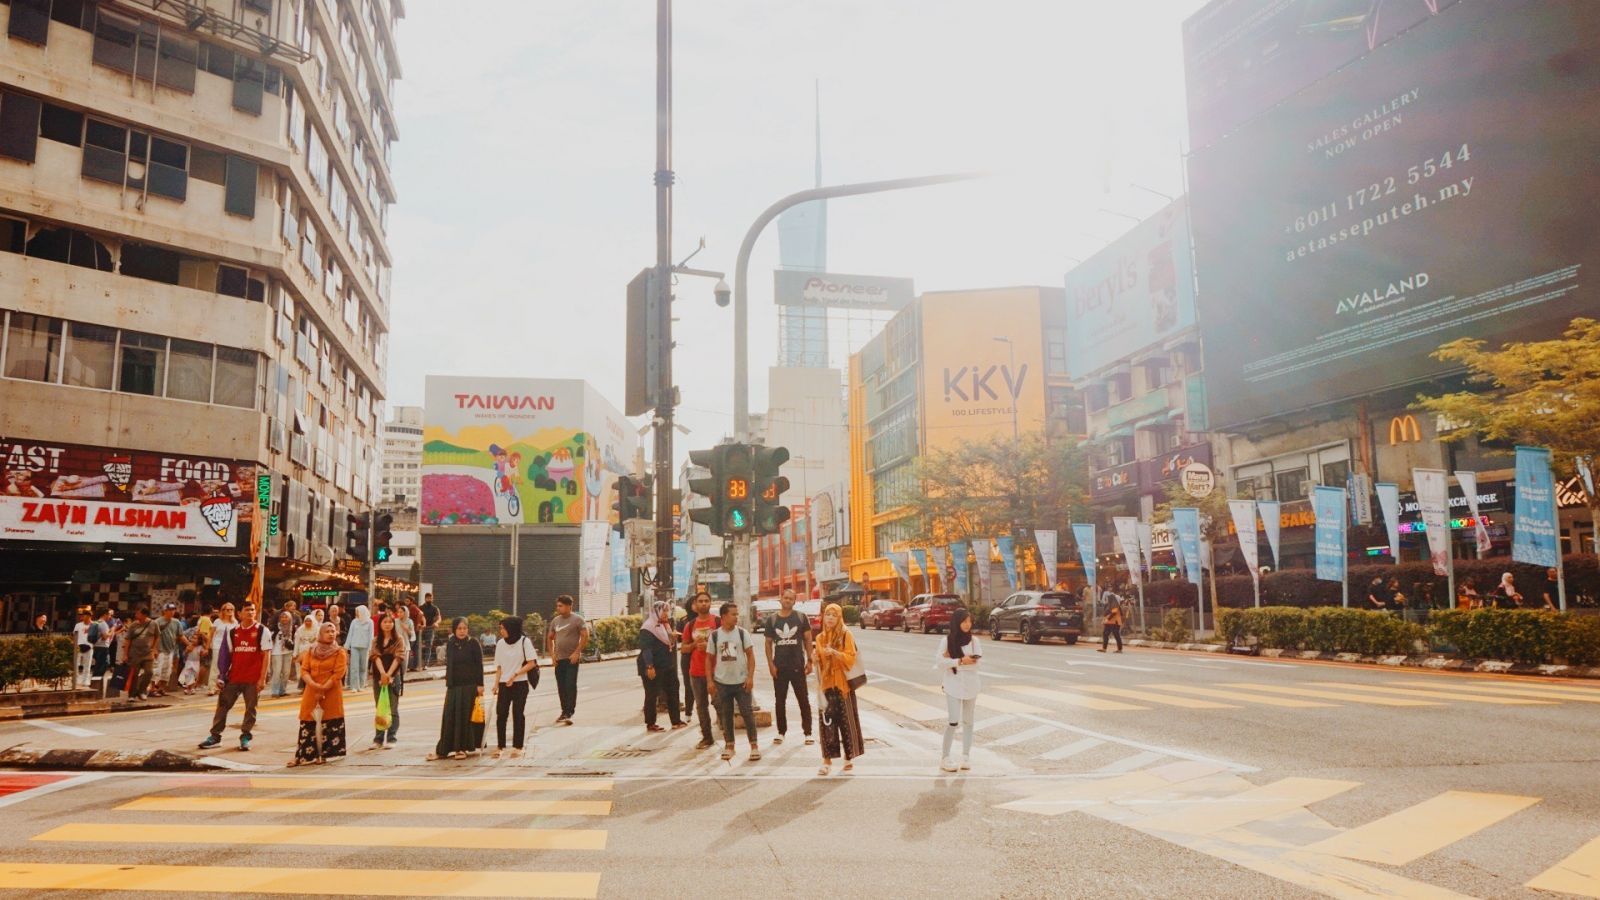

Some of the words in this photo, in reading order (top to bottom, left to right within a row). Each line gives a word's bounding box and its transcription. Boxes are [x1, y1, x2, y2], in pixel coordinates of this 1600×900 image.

[1307, 124, 1348, 153] SALES
[1353, 87, 1419, 129] GALLERY
[1325, 136, 1357, 160] NOW
[1362, 114, 1402, 141] OPEN
[1285, 202, 1337, 233] +6011
[1346, 176, 1396, 211] 1722
[1407, 143, 1471, 185] 5544
[1286, 176, 1474, 262] aetasseputeh.my
[803, 276, 889, 297] Pioneer
[1335, 272, 1429, 315] AVALAND
[454, 394, 555, 411] TAIWAN
[952, 409, 966, 417] 100
[160, 457, 230, 483] FOOD
[258, 476, 270, 509] MONEY
[730, 480, 746, 497] 33
[94, 507, 187, 529] ALSHAM
